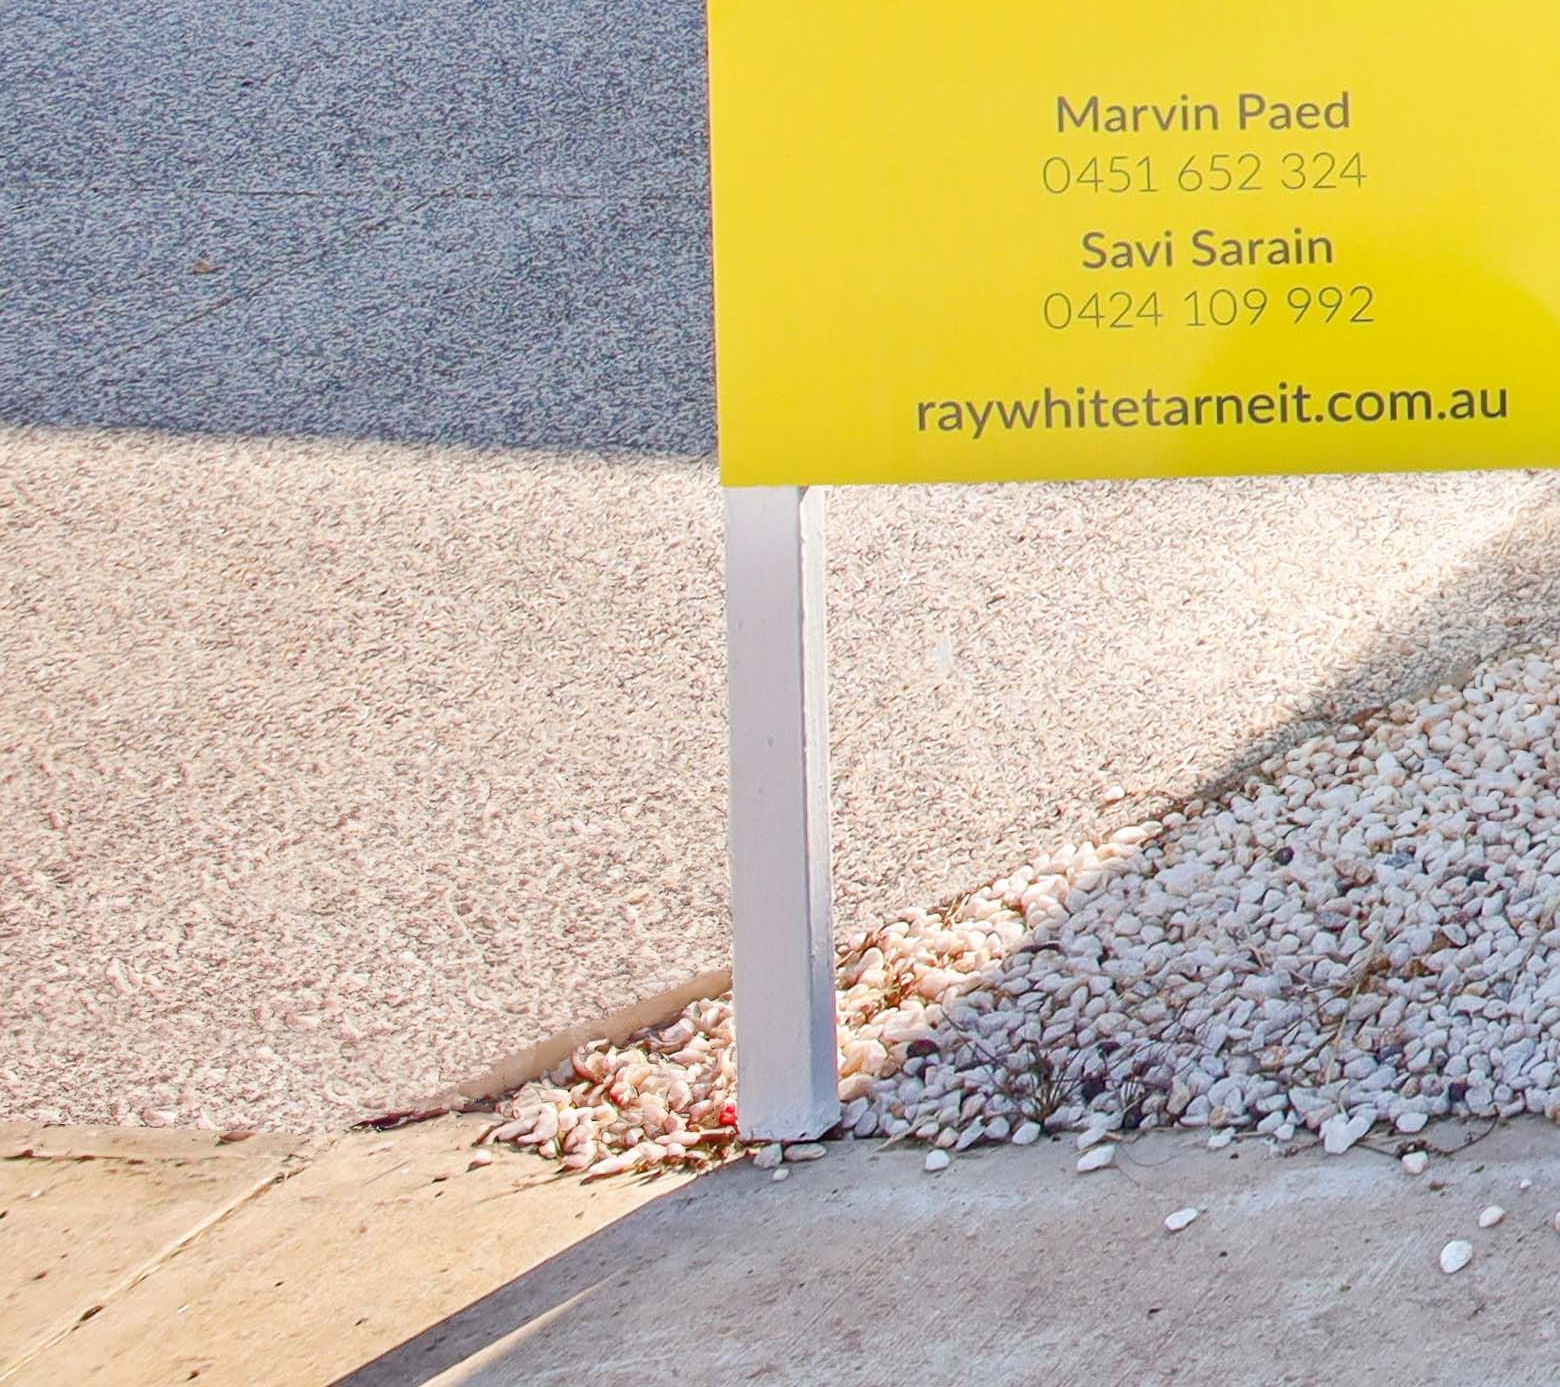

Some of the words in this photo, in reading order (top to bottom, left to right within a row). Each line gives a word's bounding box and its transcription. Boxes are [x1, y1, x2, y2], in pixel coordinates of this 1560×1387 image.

[1056, 92, 1220, 133] Marvin
[1237, 89, 1351, 132] Paed
[1042, 154, 1160, 196] 0451
[1177, 152, 1264, 193] 652
[1280, 151, 1369, 190] 324
[1082, 229, 1173, 270] Savi
[1191, 226, 1334, 268] Sarain
[1043, 290, 1164, 331] 0424
[1183, 287, 1269, 328] 109
[1286, 285, 1376, 325] 992
[917, 380, 1508, 441] raywhitetarneit.com.au
